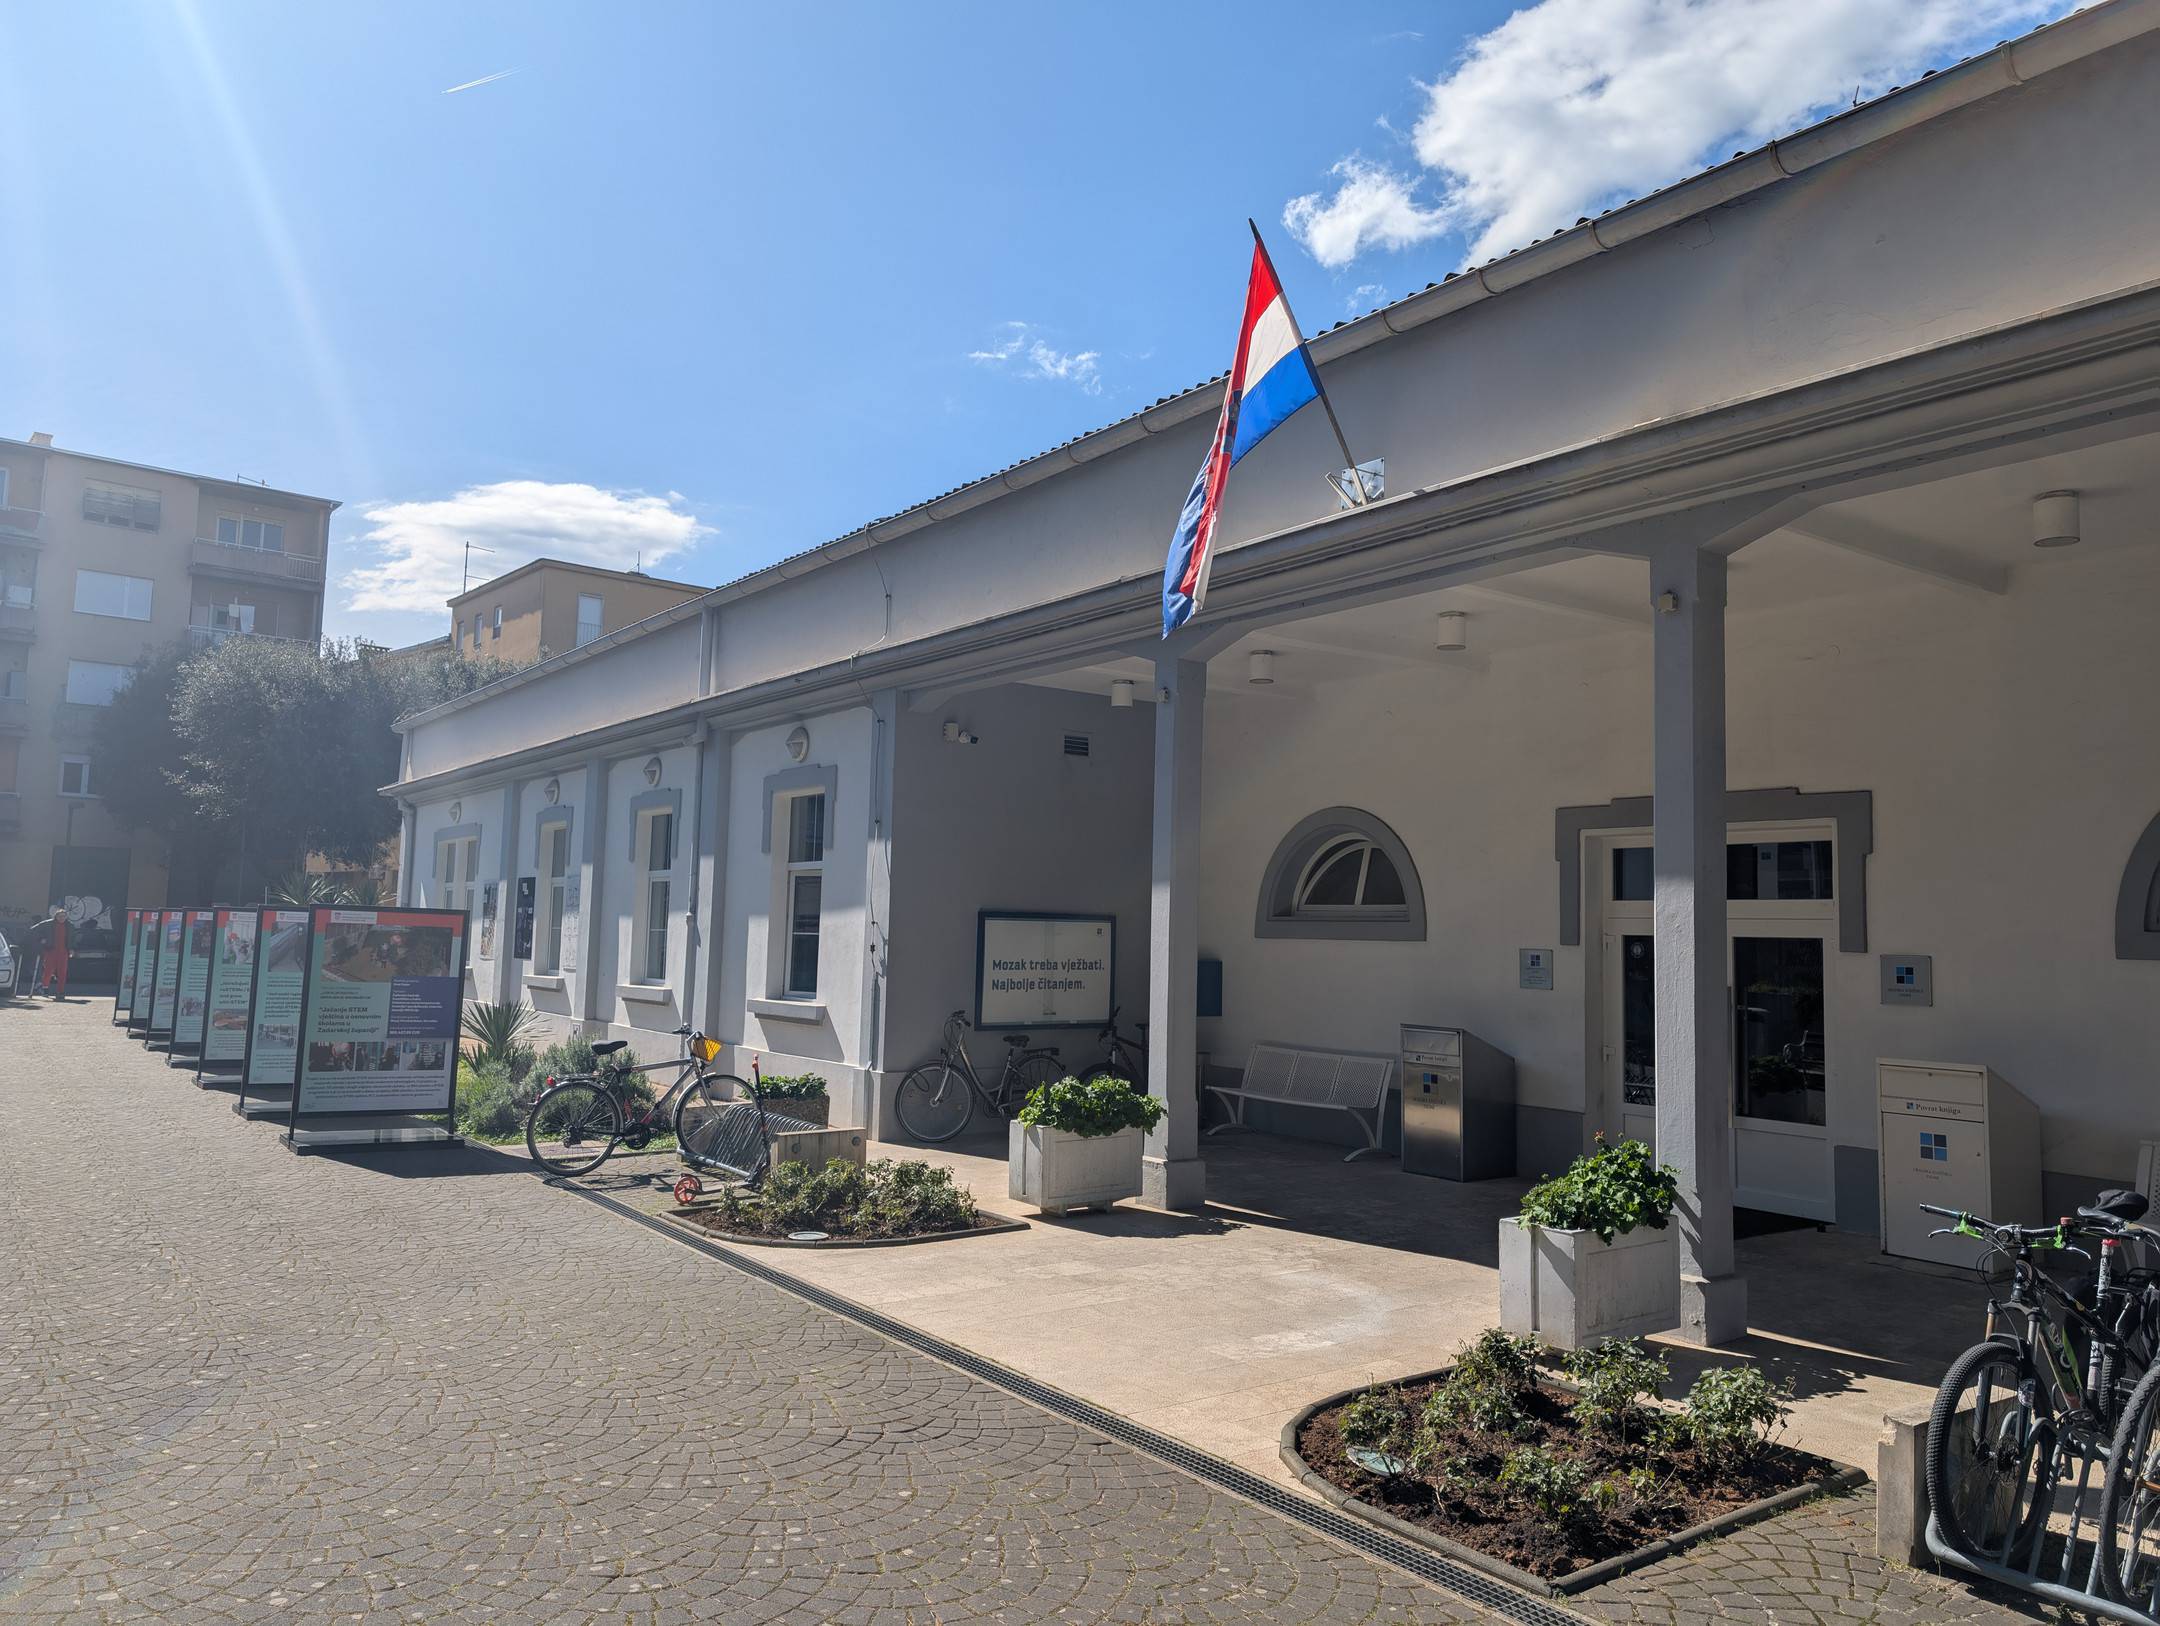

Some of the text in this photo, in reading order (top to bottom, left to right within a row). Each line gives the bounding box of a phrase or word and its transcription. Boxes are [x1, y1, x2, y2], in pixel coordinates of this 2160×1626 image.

[992, 958, 1105, 973] Mozak treba vježbati.
[992, 977, 1086, 993] Najbolje čitanjem.
[1916, 1103, 1961, 1115] Povrat knjiga
